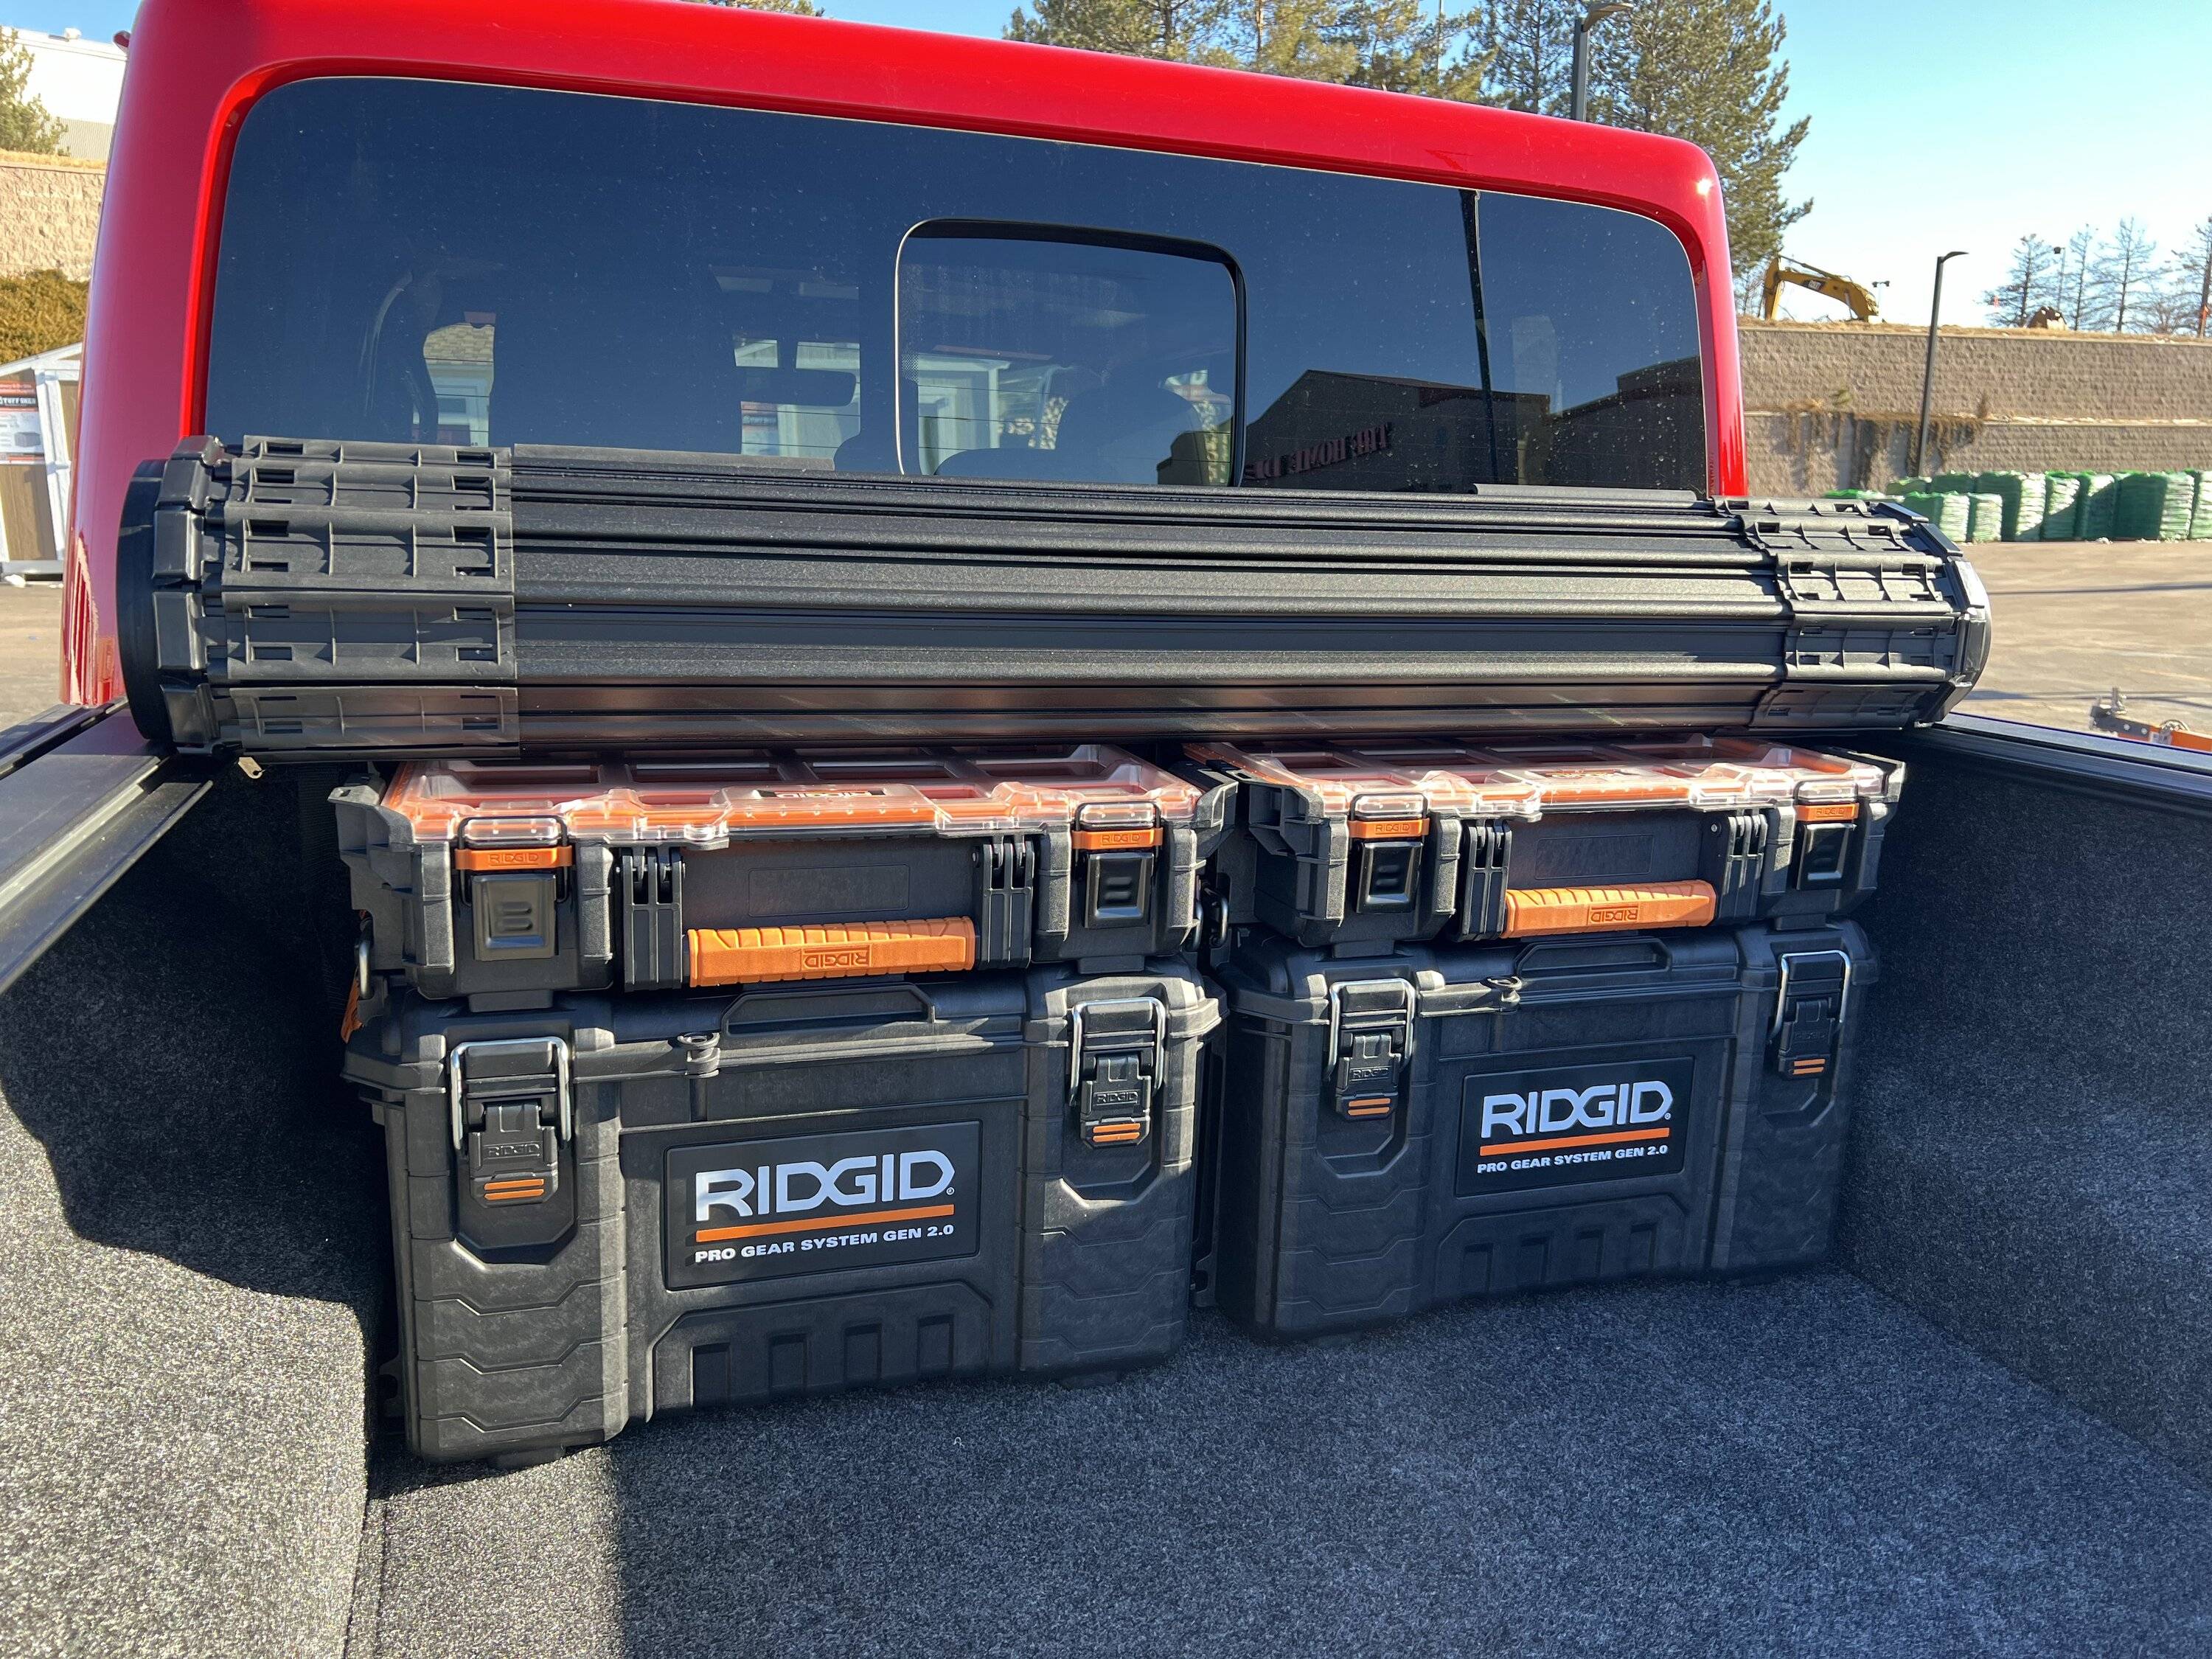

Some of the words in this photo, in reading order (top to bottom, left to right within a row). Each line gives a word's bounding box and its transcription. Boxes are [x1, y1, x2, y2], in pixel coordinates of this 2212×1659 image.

[1375, 823, 1410, 832] RIDGID
[1102, 833, 1140, 844] RIDGID
[489, 852, 539, 863] RIDGID
[1590, 909, 1638, 922] RIDGID
[804, 951, 869, 968] RIDGID
[1481, 1080, 1674, 1138] RIDGID
[1477, 1161, 1507, 1173] PRO
[1511, 1157, 1551, 1170] GEAR
[1554, 1151, 1612, 1165] SYSTEM
[1615, 1147, 1644, 1158] GEN
[1647, 1144, 1669, 1156] 2.0
[695, 1150, 956, 1222] RIDGID
[695, 1248, 737, 1263] PRO
[740, 1242, 796, 1258] GEAR
[801, 1233, 877, 1251] SYSTEM
[883, 1228, 922, 1242] GEN
[927, 1224, 955, 1236] 2.0
